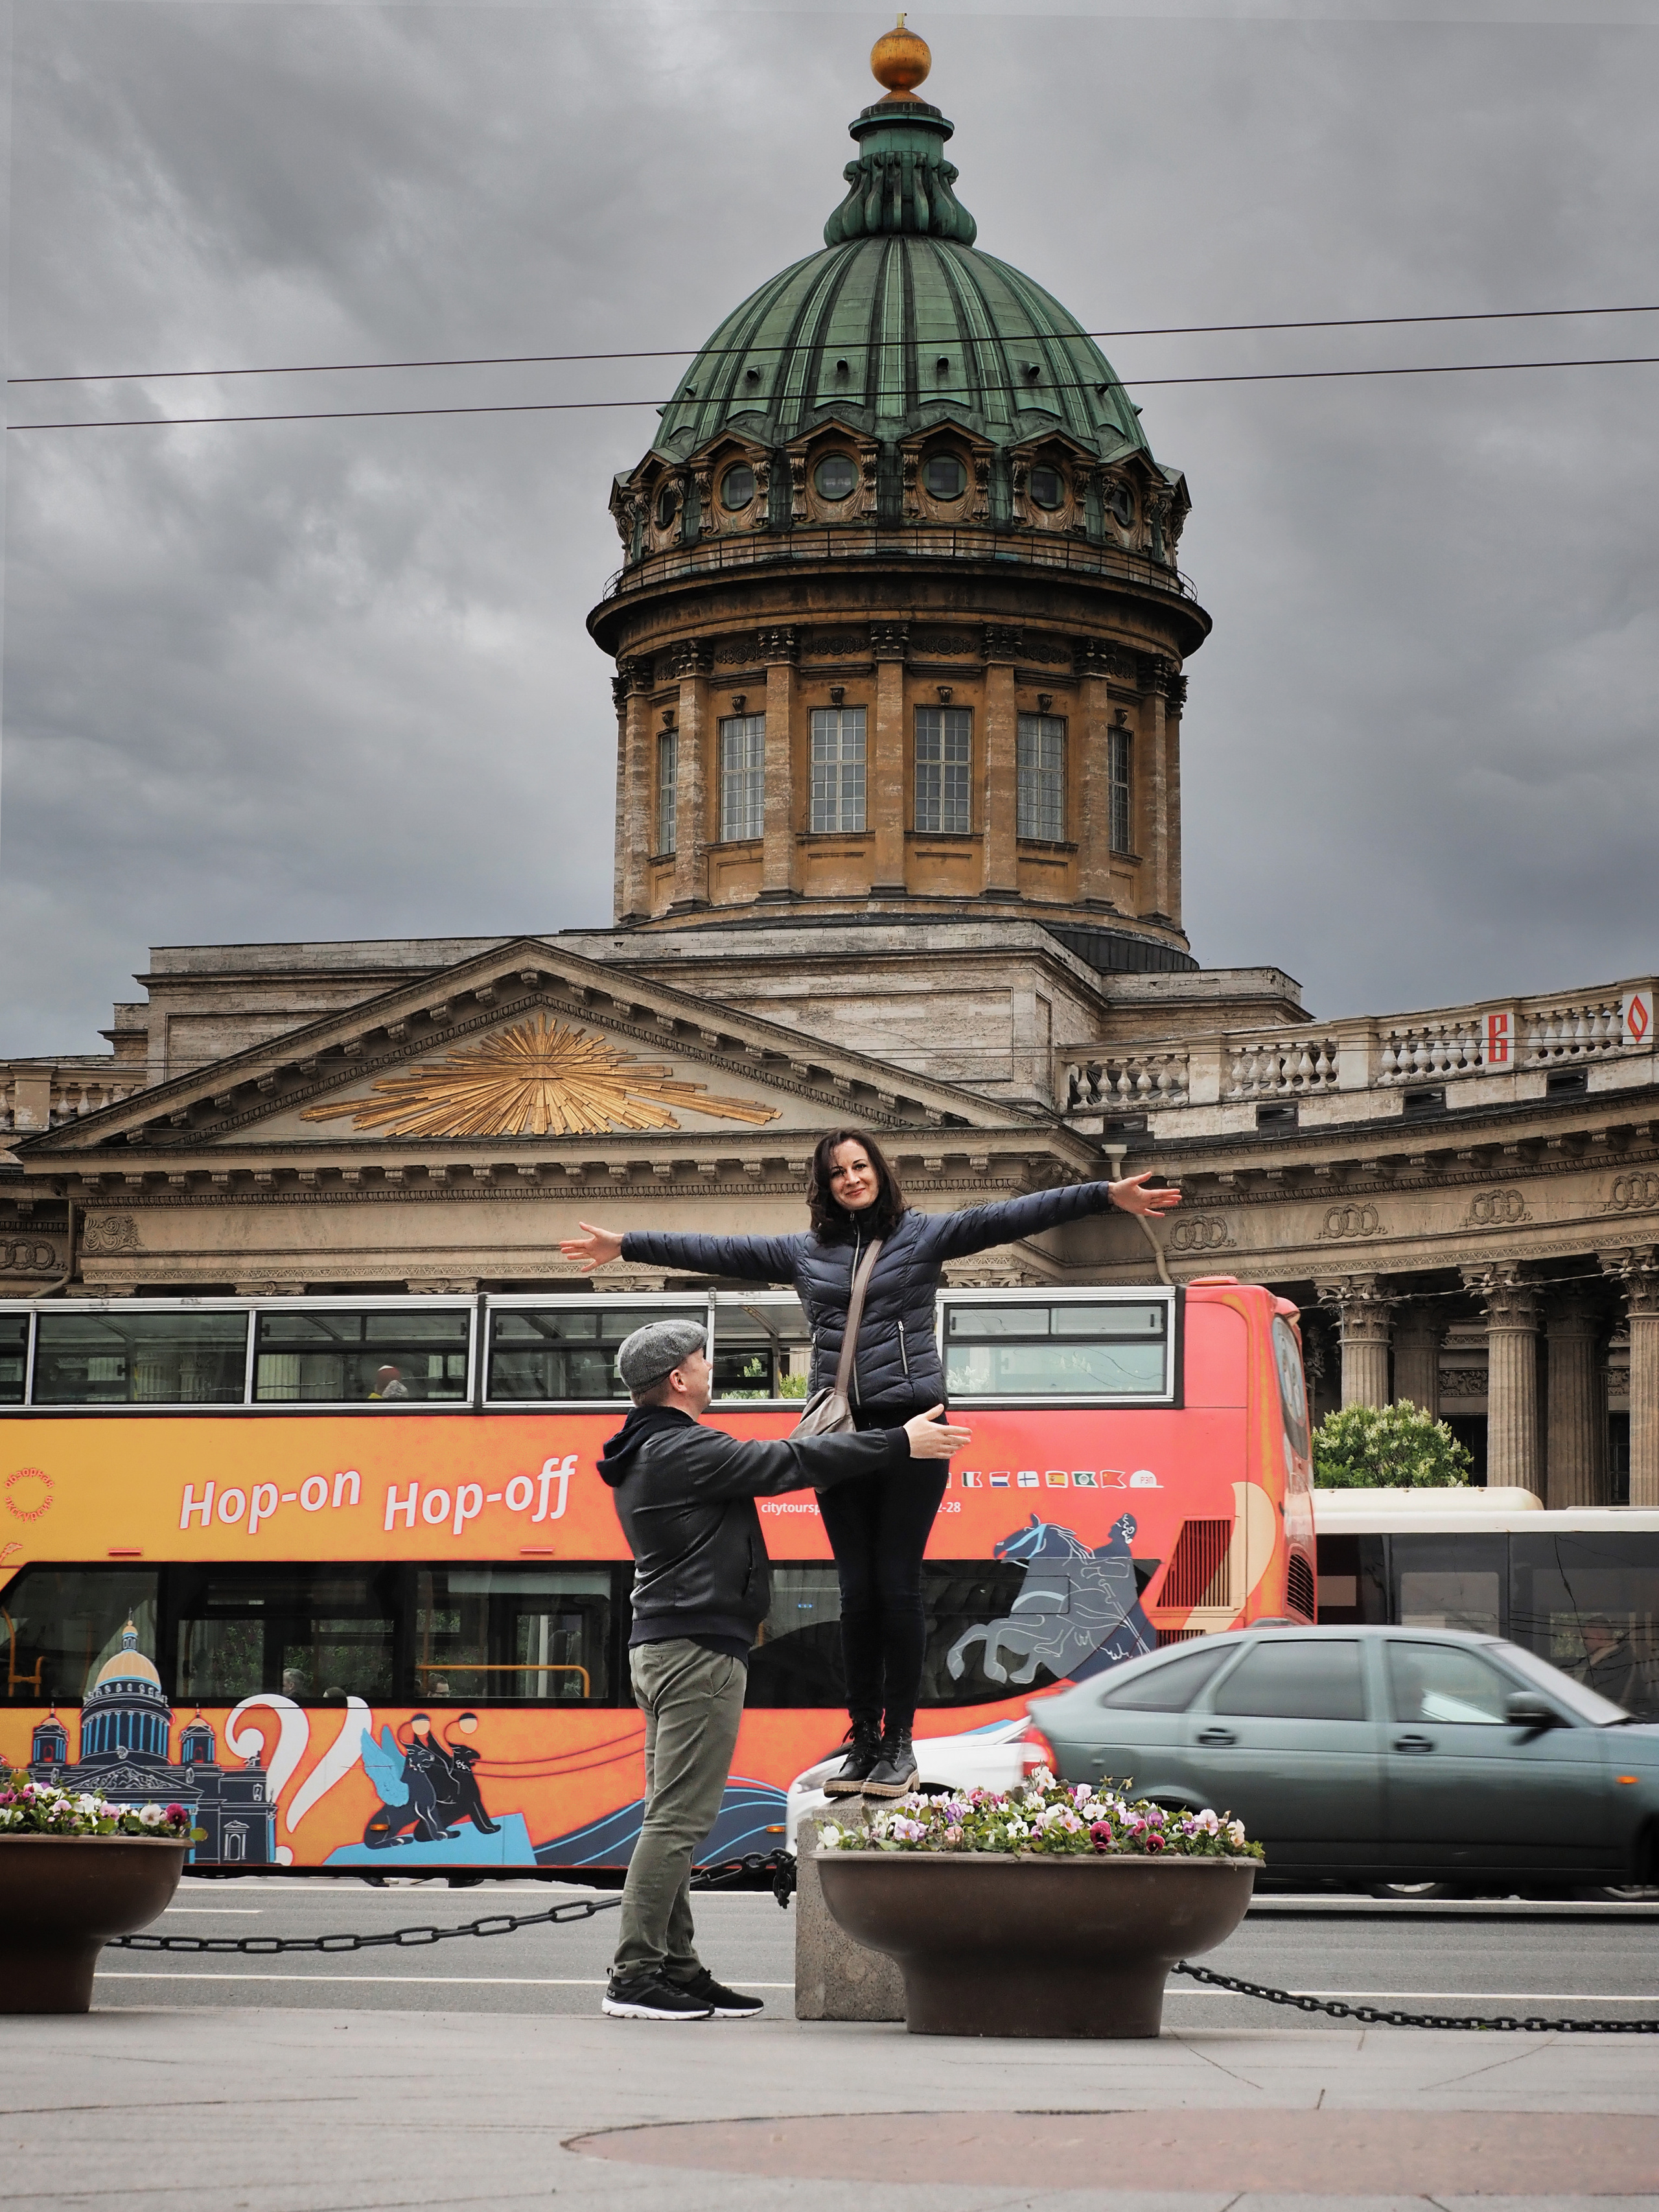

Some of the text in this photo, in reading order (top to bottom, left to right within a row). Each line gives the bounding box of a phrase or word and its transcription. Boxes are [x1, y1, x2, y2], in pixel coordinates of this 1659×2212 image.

[5, 1467, 54, 1489] обзорная
[179, 1454, 579, 1535] Hop-on Hop-off
[5, 1495, 54, 1523] экскурсия
